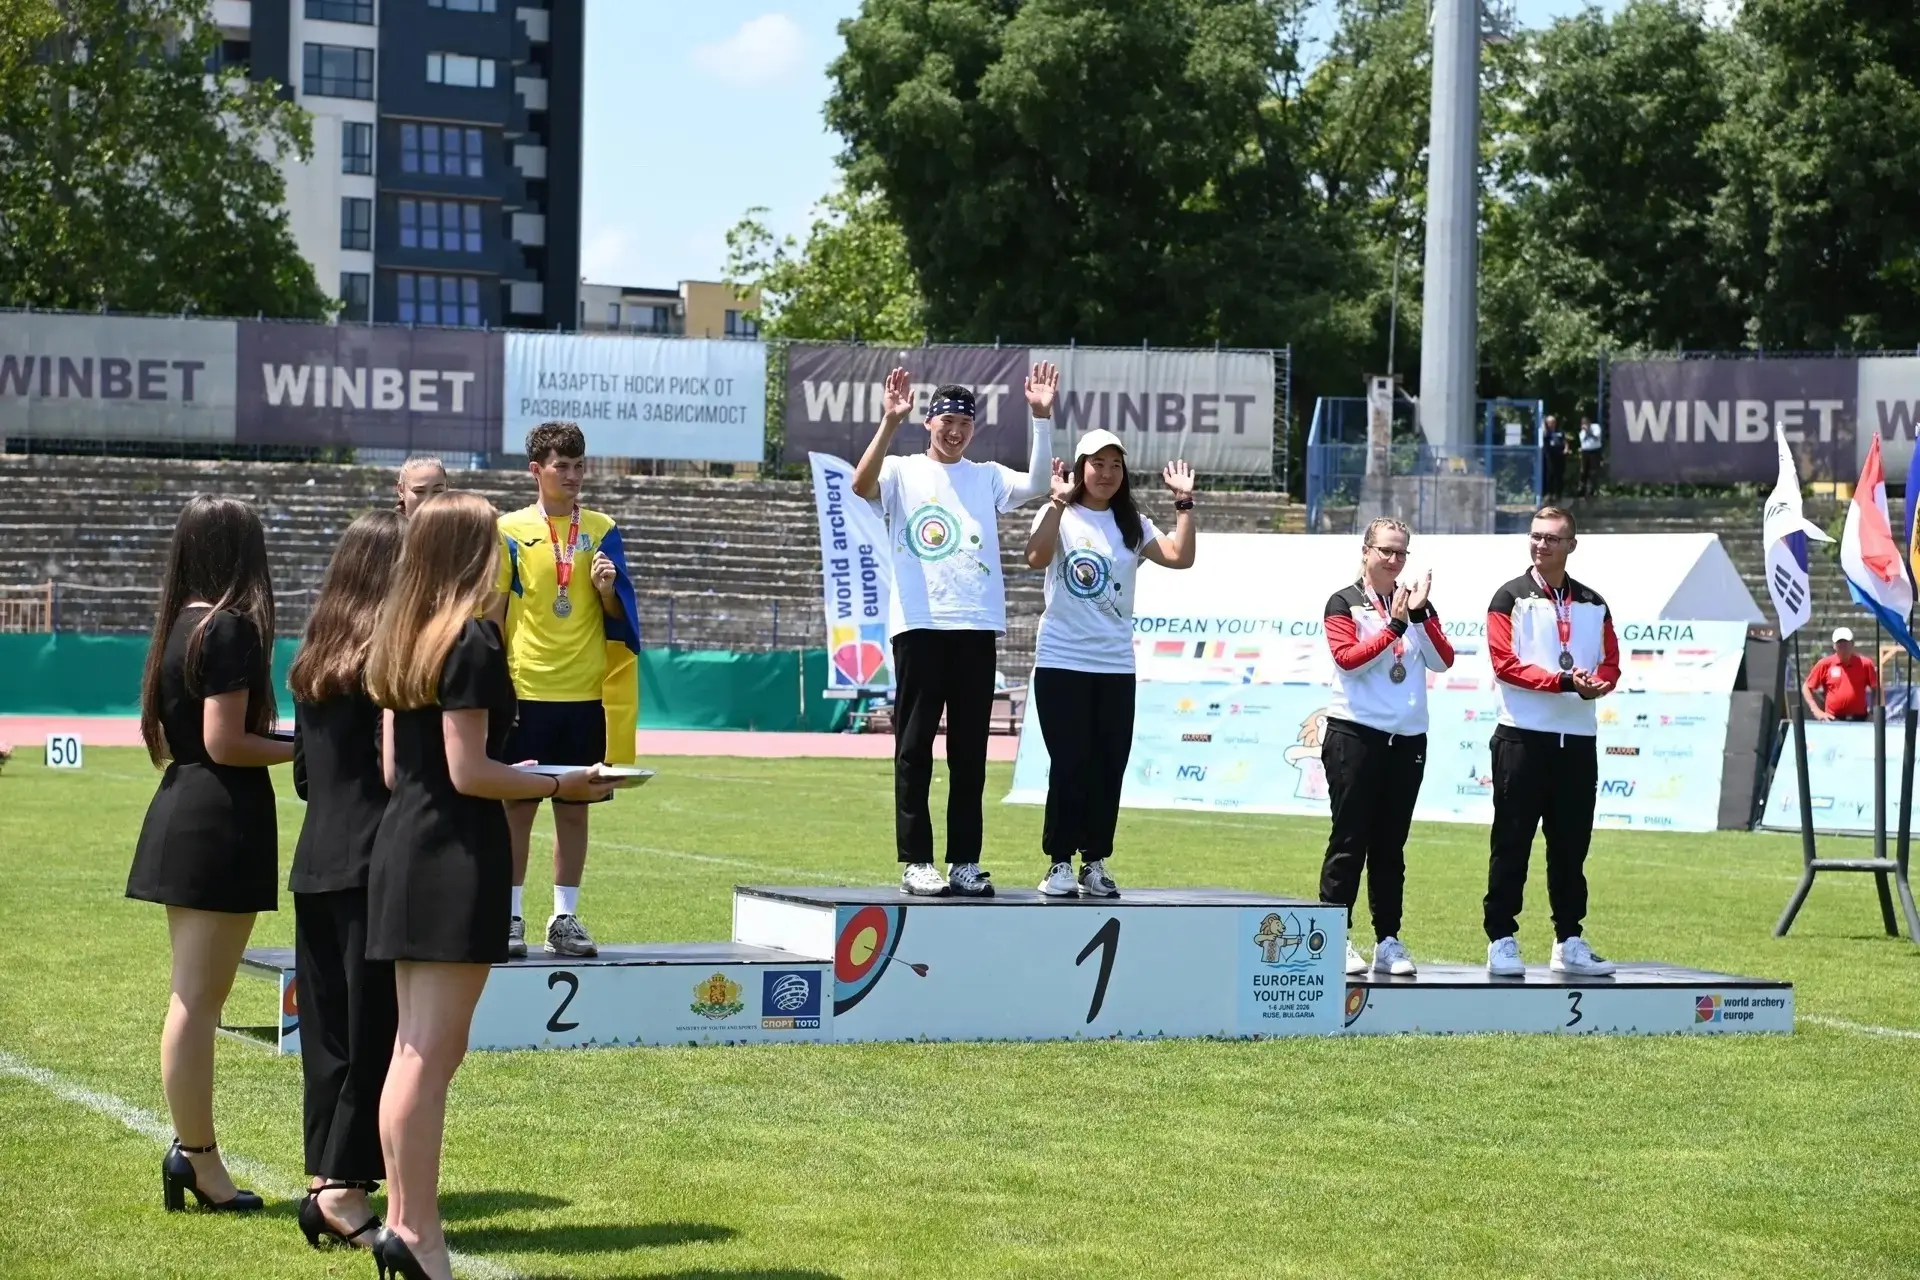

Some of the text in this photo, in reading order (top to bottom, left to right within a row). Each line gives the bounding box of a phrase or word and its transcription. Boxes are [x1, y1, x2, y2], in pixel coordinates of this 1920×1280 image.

[262, 363, 475, 413] WINBET
[537, 372, 735, 397] ХАЗАРТЪТ НОСИ РИСК ОТ
[520, 398, 748, 424] РАЗВИВАНЕ НА ЗАВИСИМОСТ
[1052, 390, 1256, 434] WINBET
[1623, 400, 1844, 443] WINBET
[824, 469, 852, 619] world archery
[858, 544, 879, 618] europe
[1132, 617, 1323, 636] ROPEAN YOUTH CU
[1623, 624, 1694, 641] GARIA
[52, 737, 78, 765] 50
[1076, 917, 1121, 1024] 1
[1253, 974, 1324, 986] EUROPEAN
[546, 971, 580, 1032] 2
[1253, 990, 1324, 1001] YOUTH CUP
[1566, 991, 1583, 1026] 3
[1724, 996, 1785, 1009] world archery
[1262, 1011, 1281, 1019] RUSE,
[1723, 1011, 1754, 1021] europe
